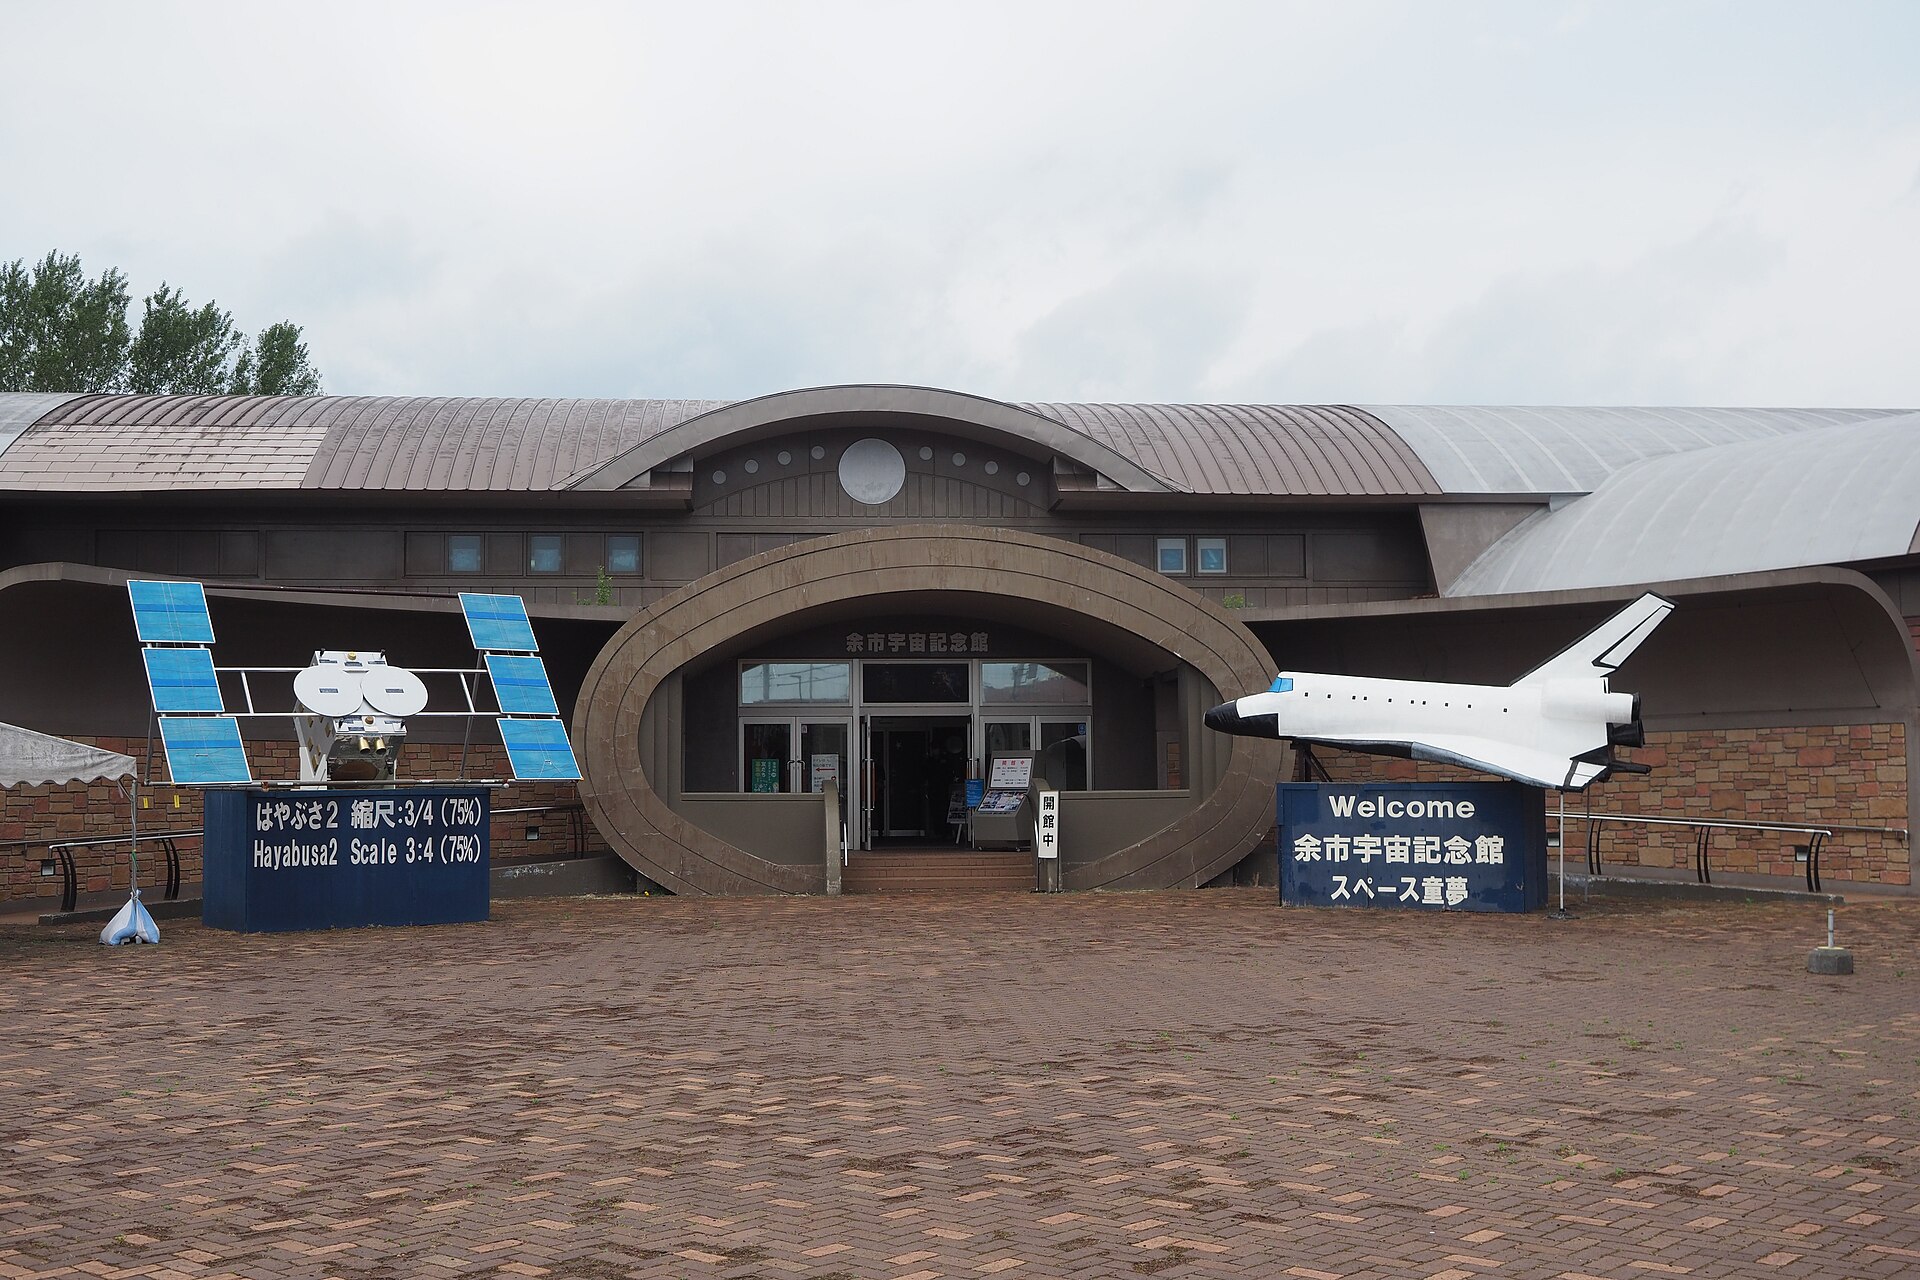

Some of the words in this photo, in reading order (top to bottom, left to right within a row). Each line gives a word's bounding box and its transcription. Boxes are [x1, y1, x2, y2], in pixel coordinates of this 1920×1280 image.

[846, 632, 989, 653] 余市宇宙記念館
[256, 800, 339, 831] はやぶさ2
[1042, 796, 1055, 847] 開館中
[1328, 795, 1475, 819] Welcome
[253, 838, 338, 871] Hayabusa2
[350, 837, 397, 865] Scale
[406, 837, 433, 864] 3:4
[1294, 833, 1504, 865] 余市宇宙記念館
[1330, 875, 1469, 906] スペース童夢
